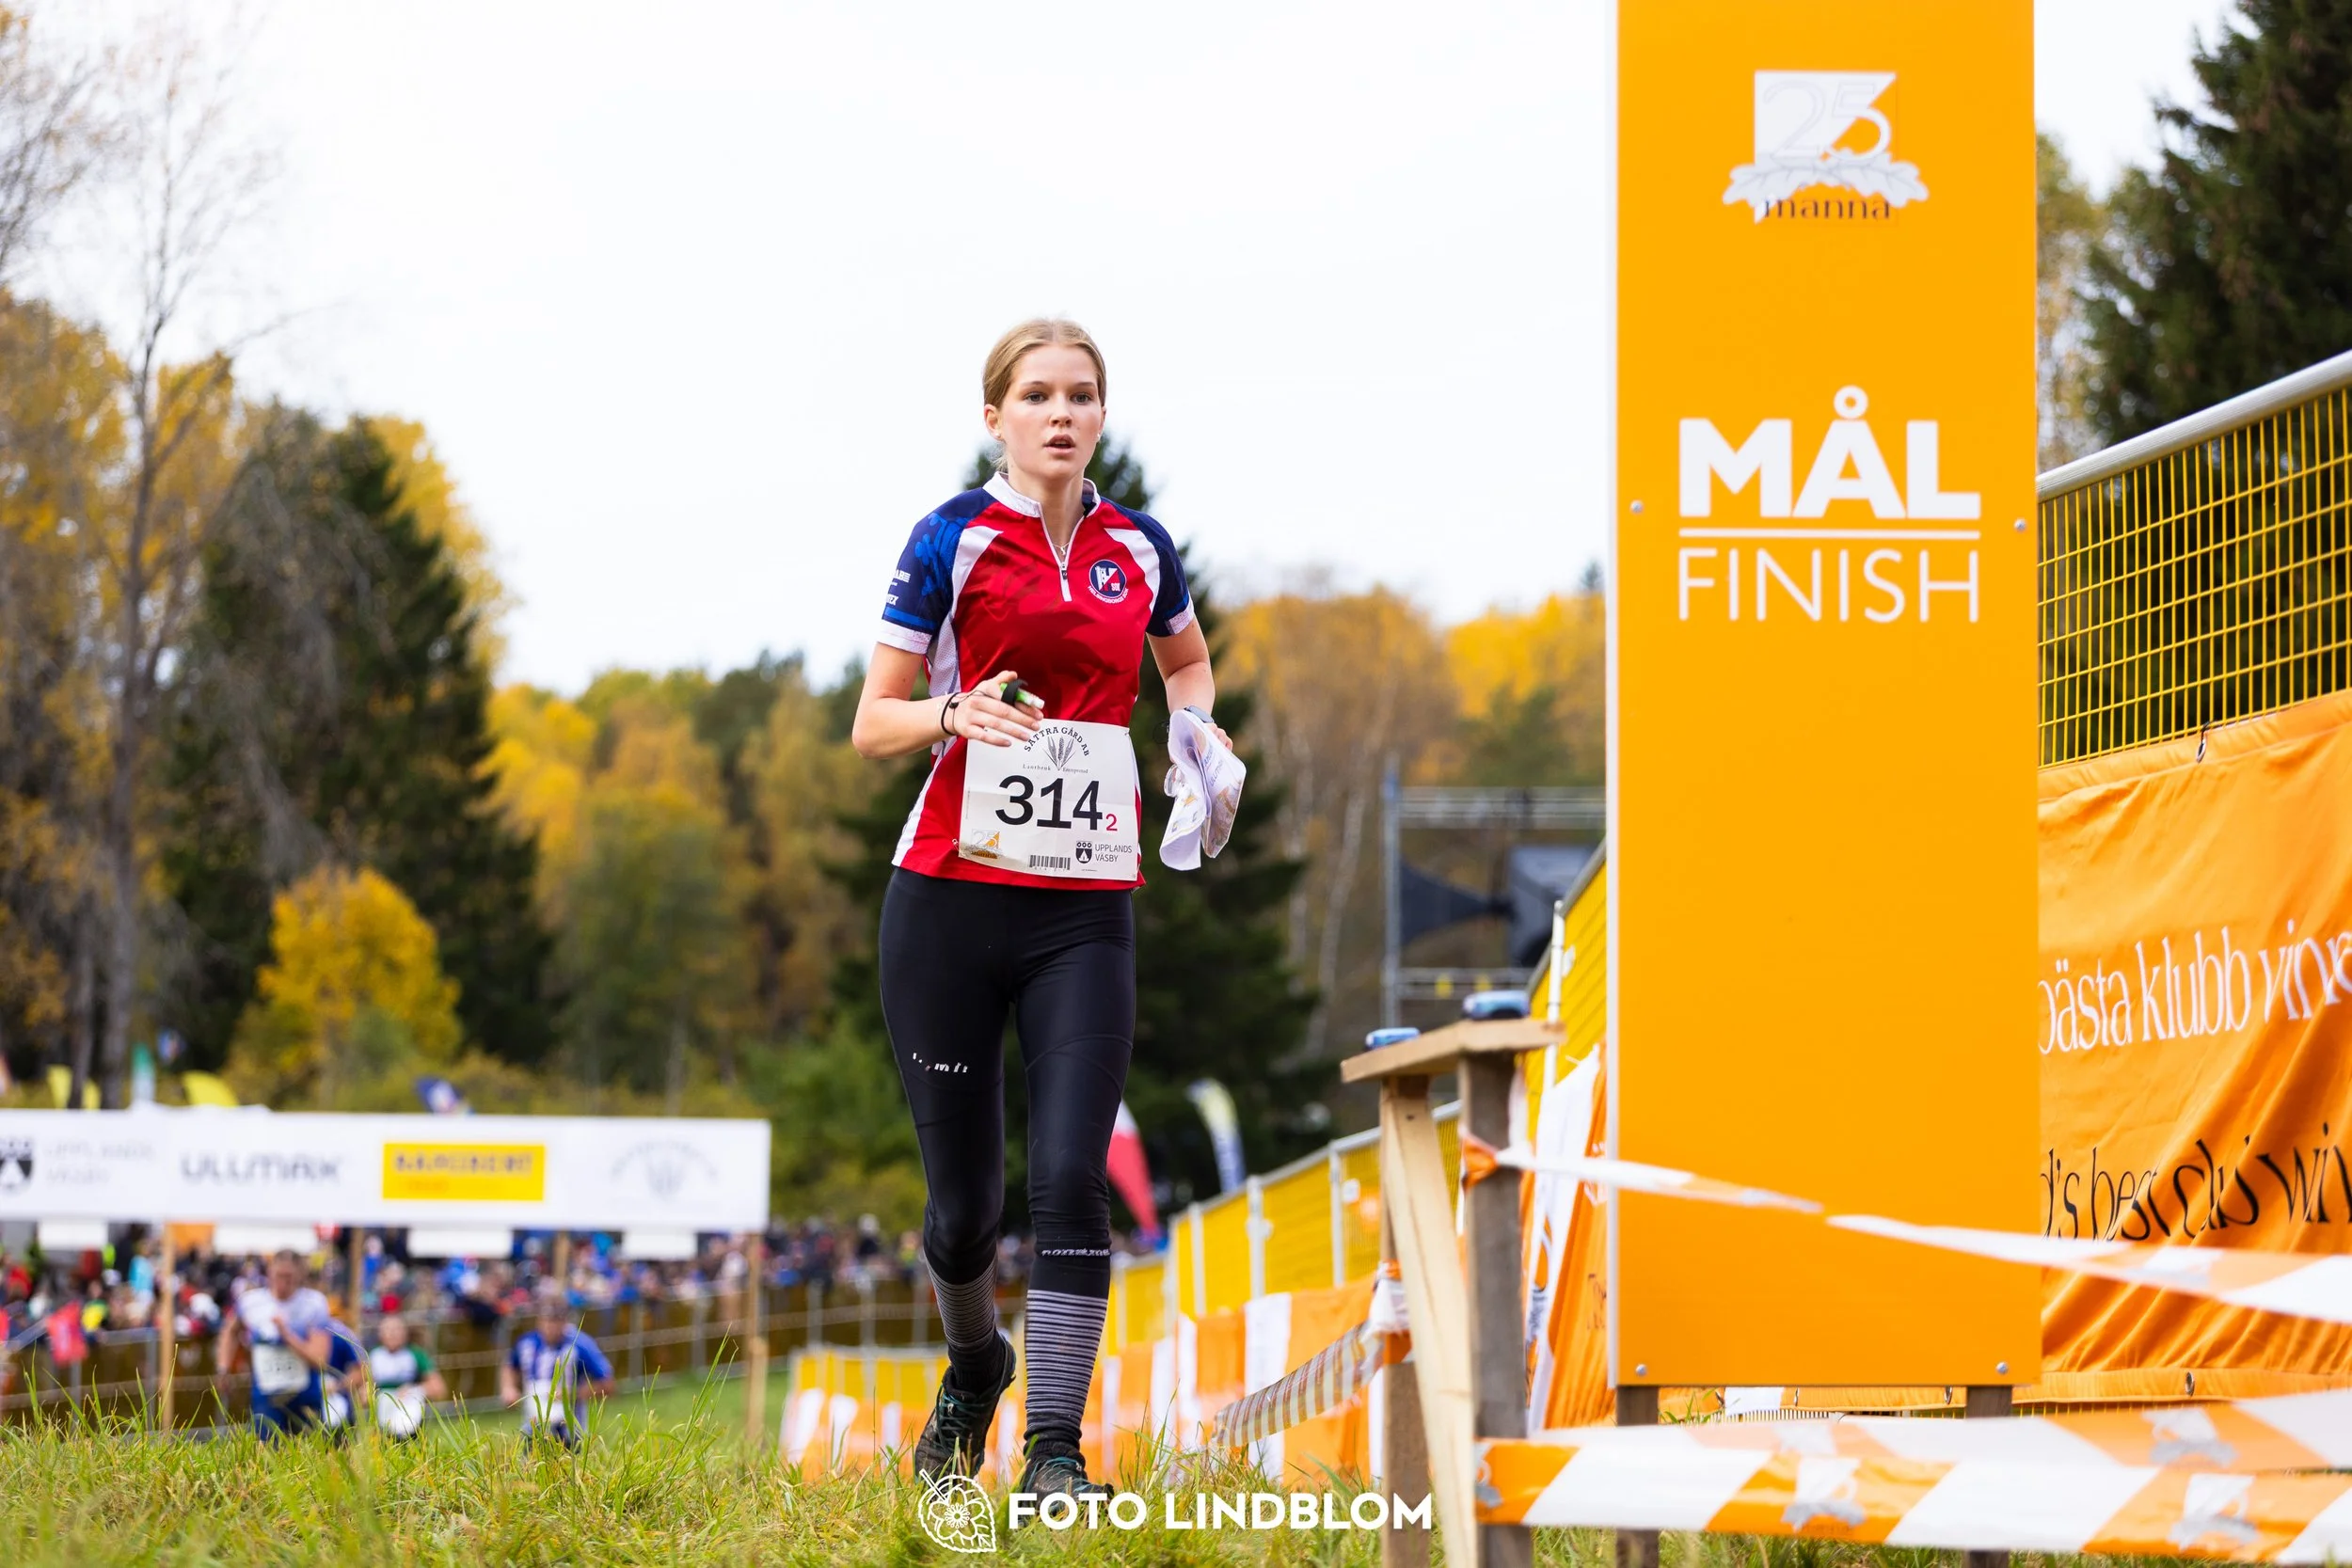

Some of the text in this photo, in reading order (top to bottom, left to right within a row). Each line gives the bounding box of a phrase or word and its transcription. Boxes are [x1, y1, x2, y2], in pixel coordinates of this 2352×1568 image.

[1762, 79, 1891, 162] 25
[1764, 198, 1891, 220] manna
[1679, 386, 1981, 519] MÅL
[1679, 548, 1979, 623] FINISH
[1061, 726, 1083, 743] GÅRD
[1081, 743, 1089, 756] AB
[995, 774, 1104, 831] 314
[1105, 813, 1118, 832] 2
[1094, 844, 1133, 854] UPPLANDS
[1095, 853, 1119, 863] VÄSBY
[2135, 925, 2252, 1041] klubb
[181, 1153, 344, 1182] ULLMAX
